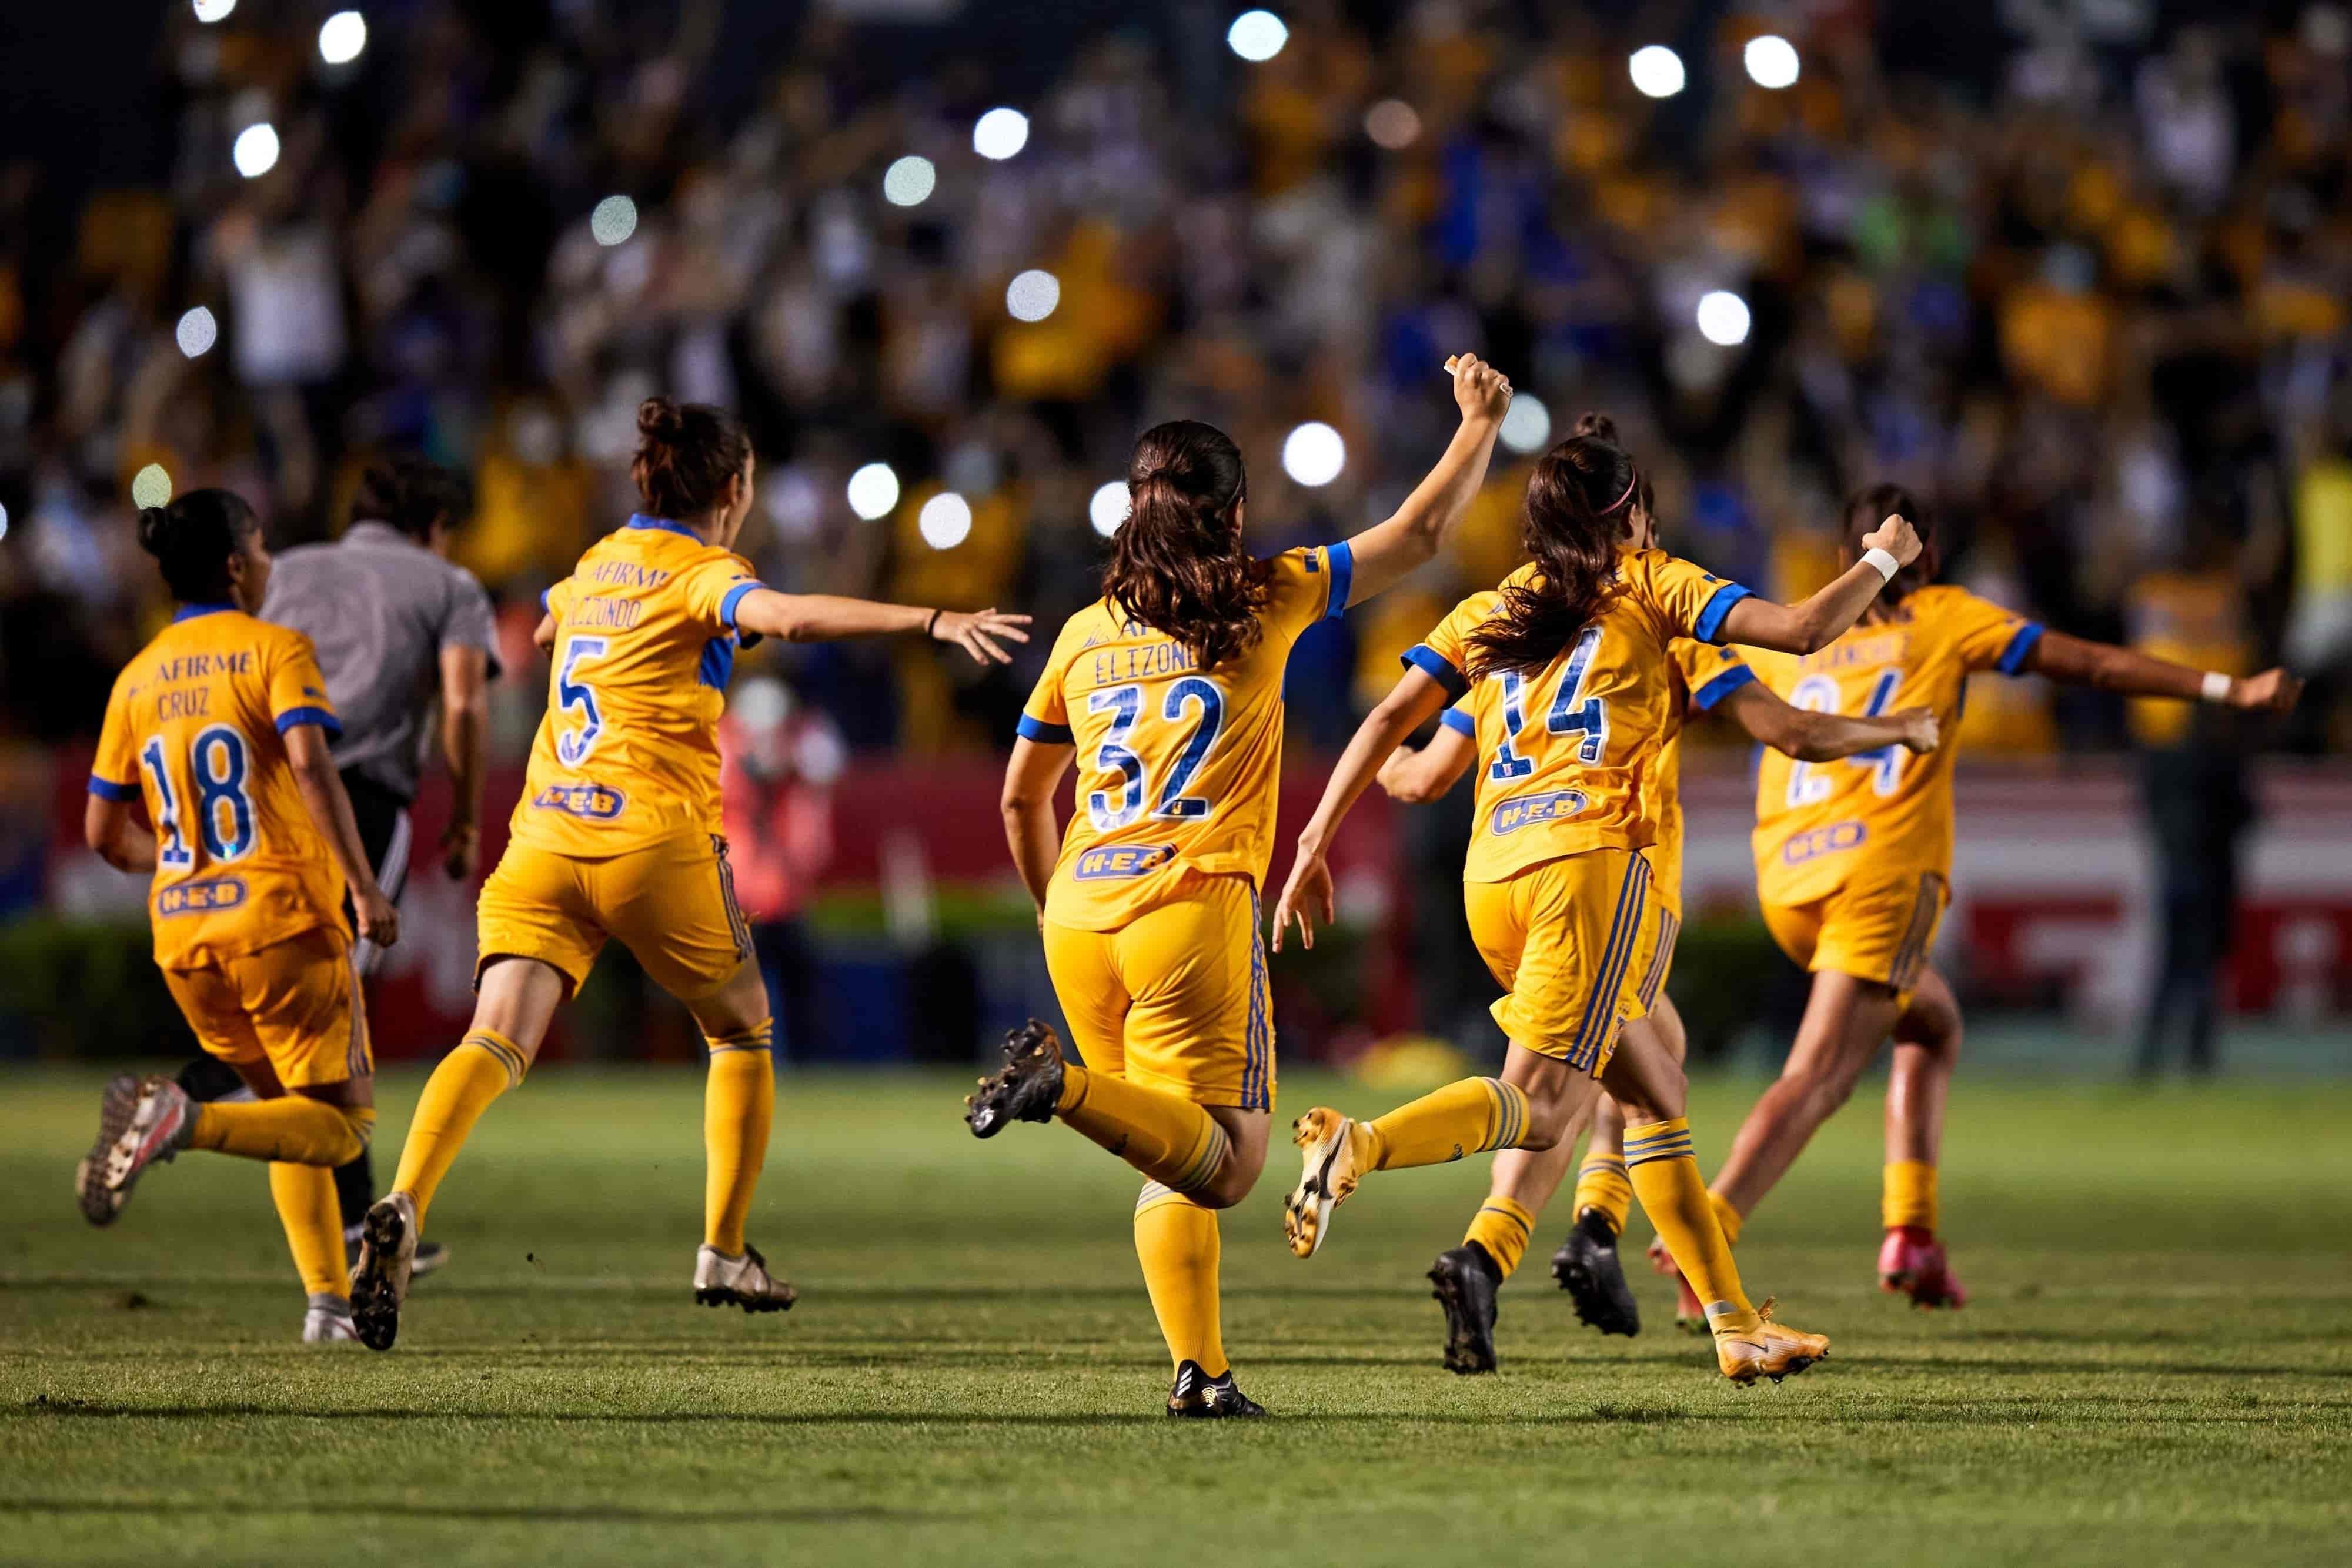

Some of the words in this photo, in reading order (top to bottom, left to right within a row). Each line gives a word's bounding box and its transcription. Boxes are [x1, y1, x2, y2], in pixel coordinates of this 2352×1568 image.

[568, 597, 642, 627] IZONDO
[1095, 641, 1201, 685] ELIZON
[157, 686, 210, 723] CRUZ
[557, 635, 608, 768] 5
[1087, 676, 1224, 833] 32
[1489, 625, 1609, 784] 14
[139, 723, 259, 872] 18
